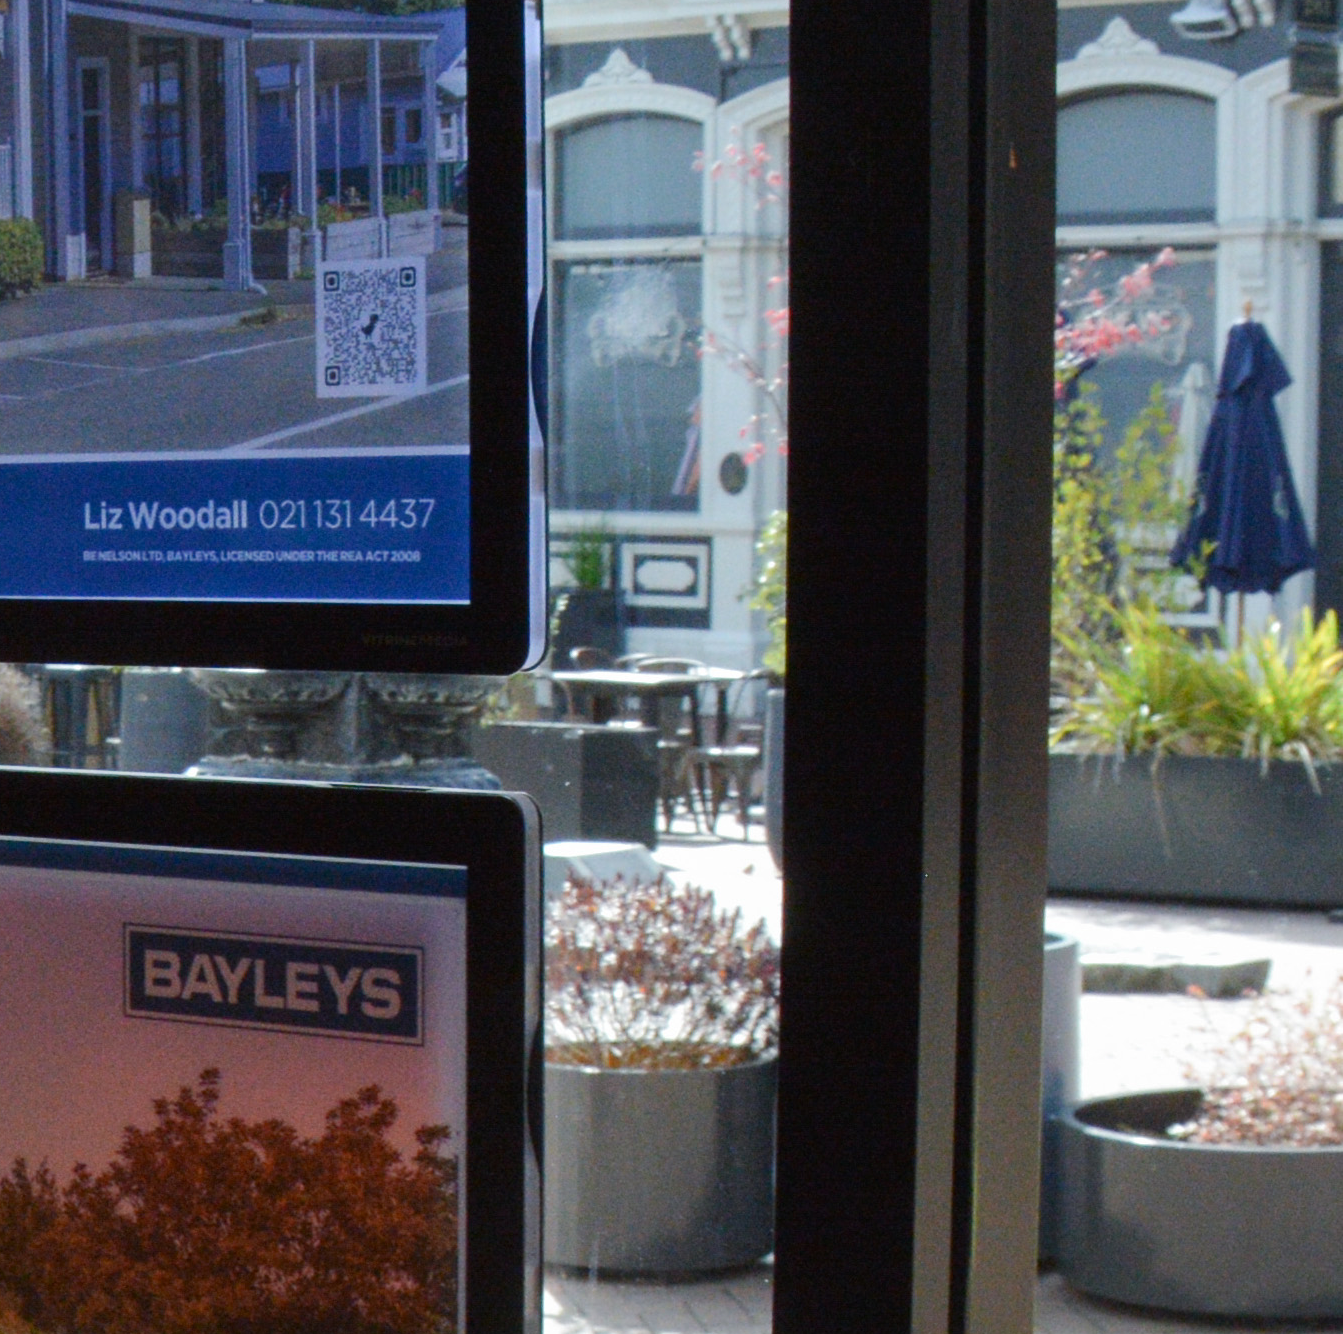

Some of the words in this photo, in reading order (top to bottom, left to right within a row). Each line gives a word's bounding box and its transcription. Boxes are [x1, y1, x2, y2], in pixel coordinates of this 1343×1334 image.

[84, 502, 123, 531] Liz
[129, 500, 247, 530] Woodall
[258, 499, 305, 528] 021
[313, 499, 351, 528] 131
[359, 499, 435, 528] 4437
[167, 551, 219, 563] BAYLEYS,
[220, 551, 275, 562] LICENSED
[365, 551, 389, 562] ACT
[144, 949, 402, 1021] BAYLEYS
